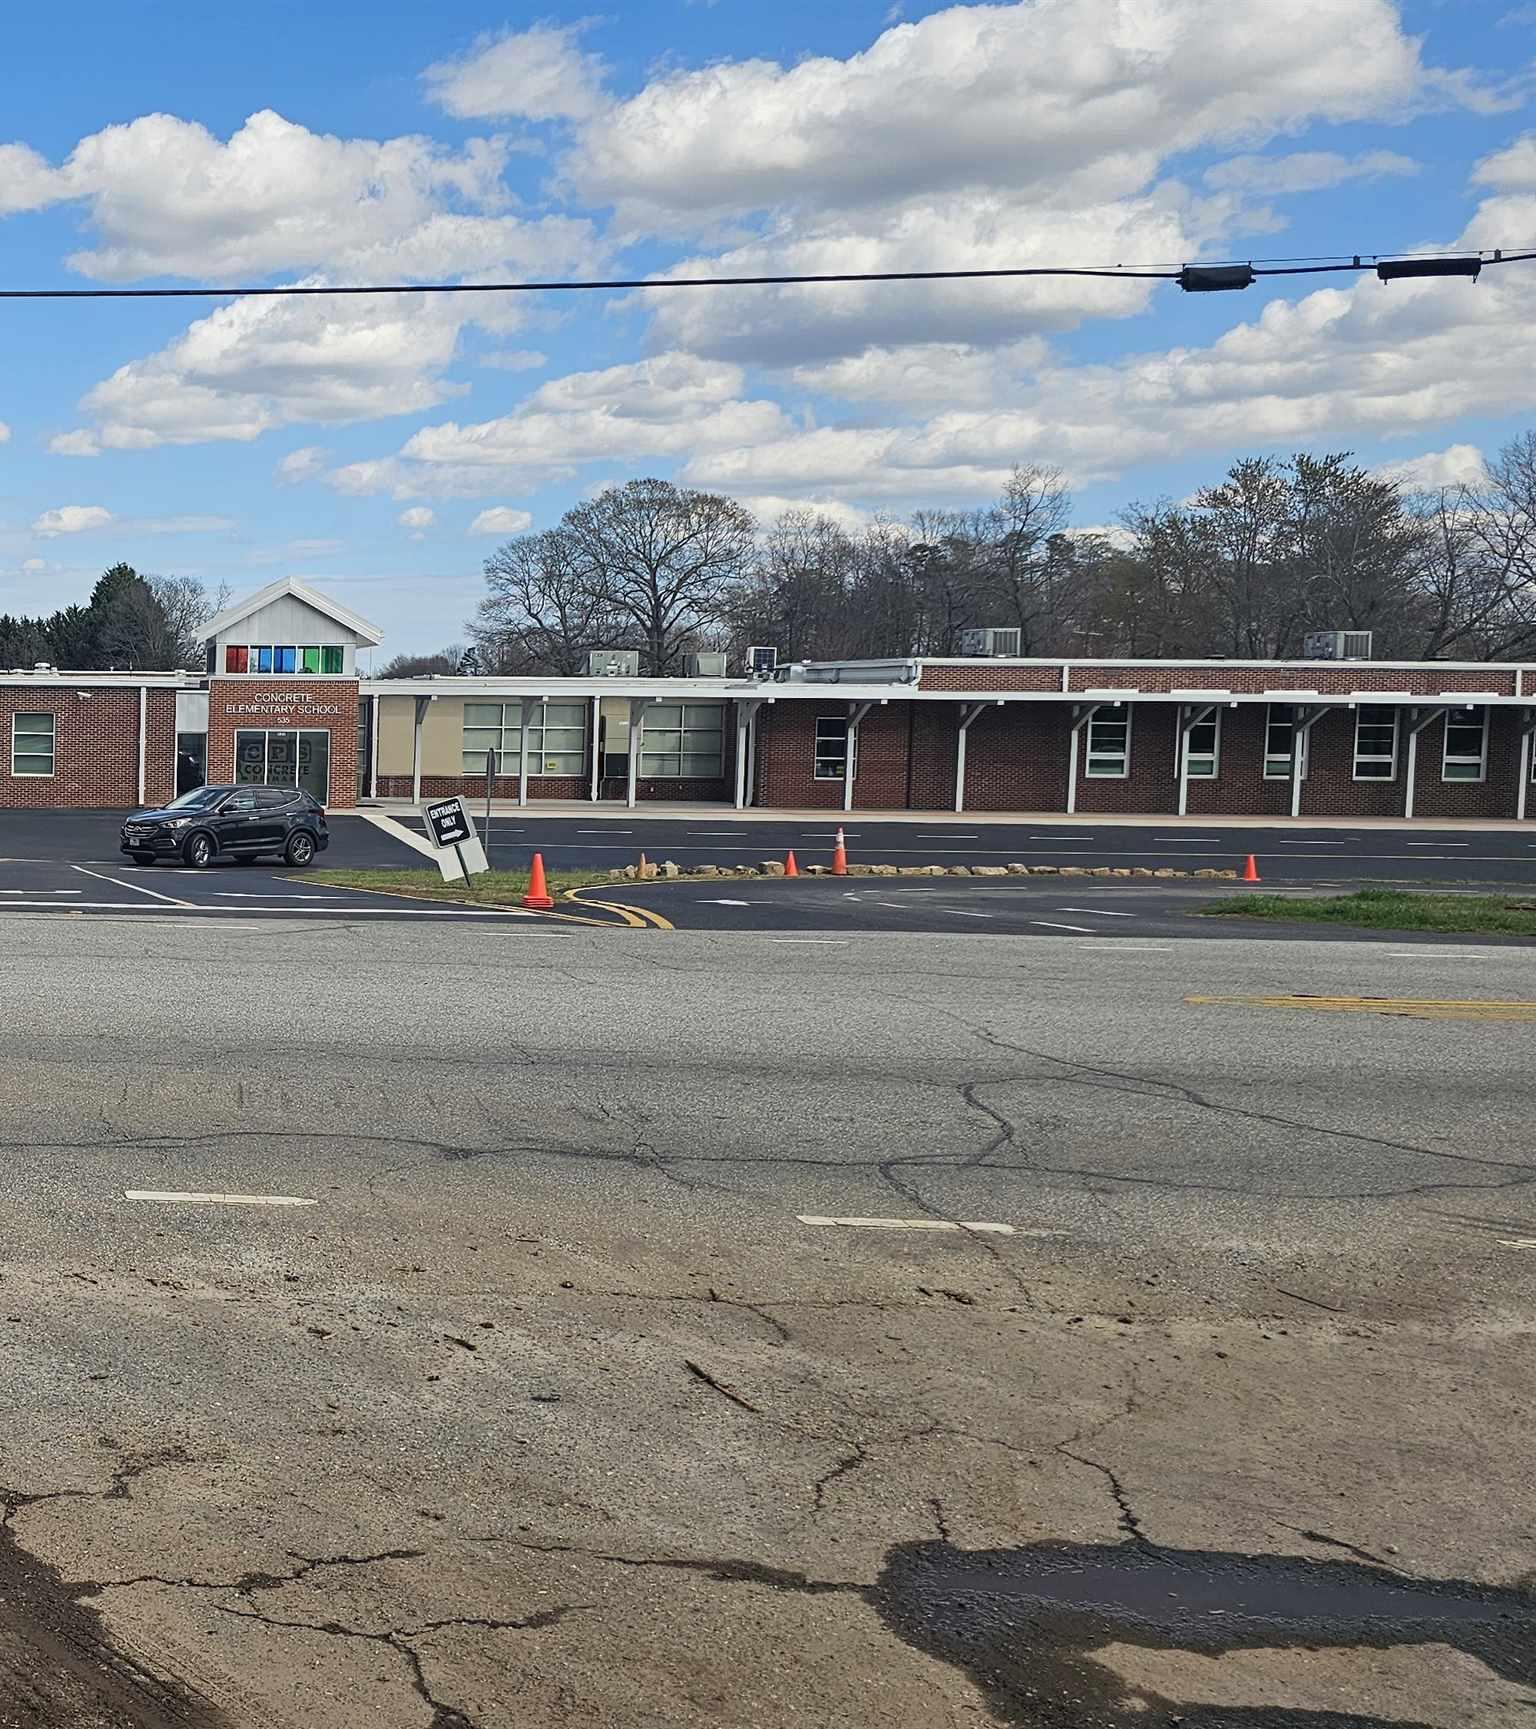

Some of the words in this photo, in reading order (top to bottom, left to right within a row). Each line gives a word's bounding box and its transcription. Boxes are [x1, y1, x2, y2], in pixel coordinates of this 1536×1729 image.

[254, 693, 313, 703] CONCRETE
[225, 704, 295, 714] ELEMENTARY
[297, 704, 342, 714] SCHOOL
[430, 802, 461, 819] ENTRANCE
[441, 815, 457, 828] ONLY
